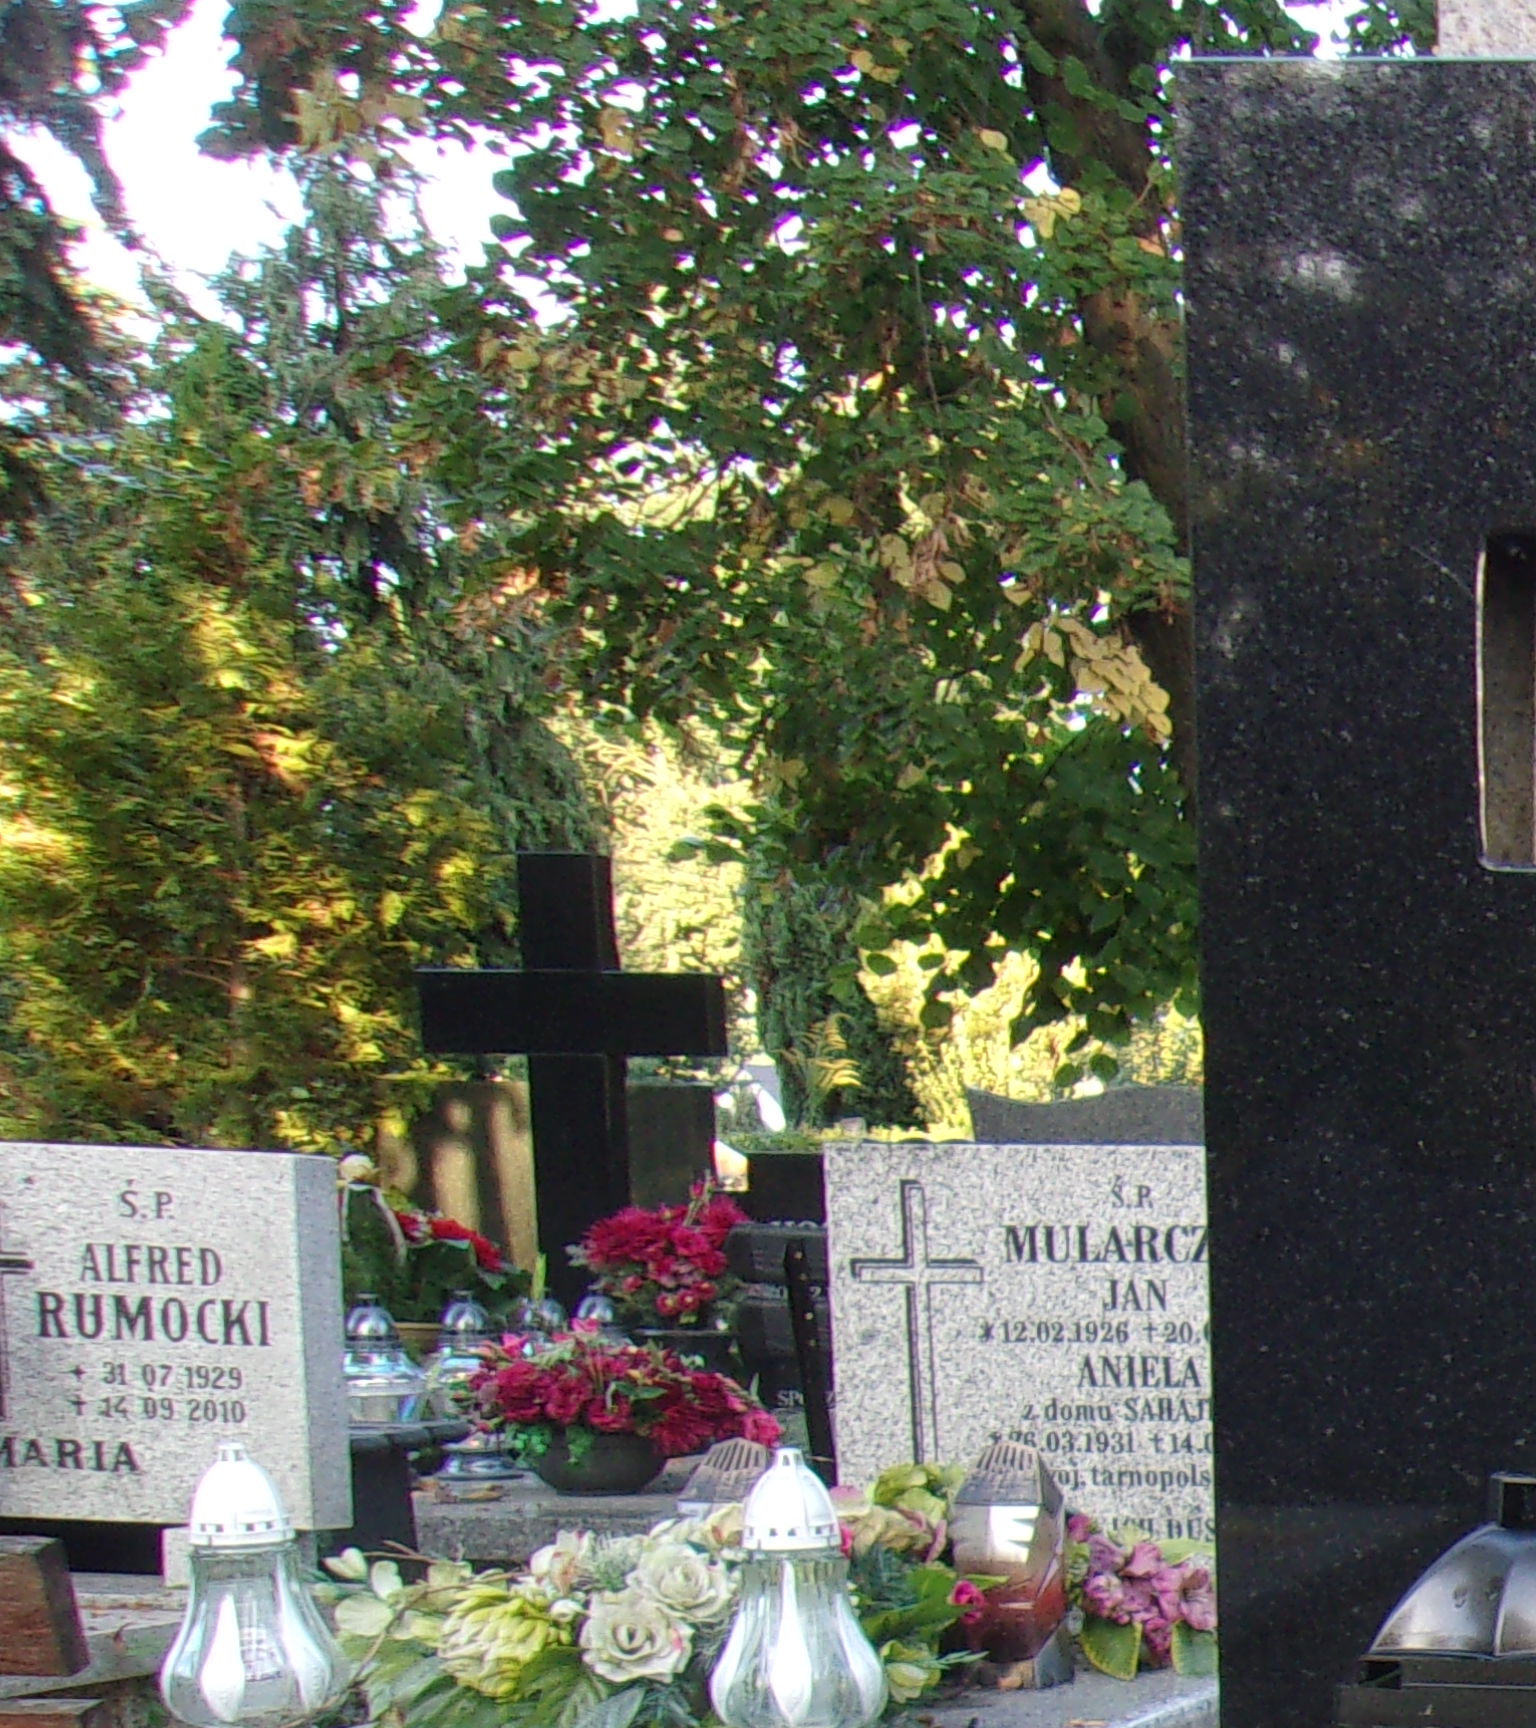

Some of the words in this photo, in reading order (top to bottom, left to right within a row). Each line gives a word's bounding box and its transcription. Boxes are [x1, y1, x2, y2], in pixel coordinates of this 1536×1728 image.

[80, 1243, 223, 1287] ALFRED
[1103, 1278, 1168, 1313] JAN
[35, 1291, 271, 1347] RUMOCKI
[184, 1365, 243, 1390] 1929
[1078, 1352, 1201, 1389] ANIELA
[187, 1398, 247, 1424] 2010
[1044, 1396, 1113, 1423] domu
[1091, 1463, 1212, 1493] tarnopols
